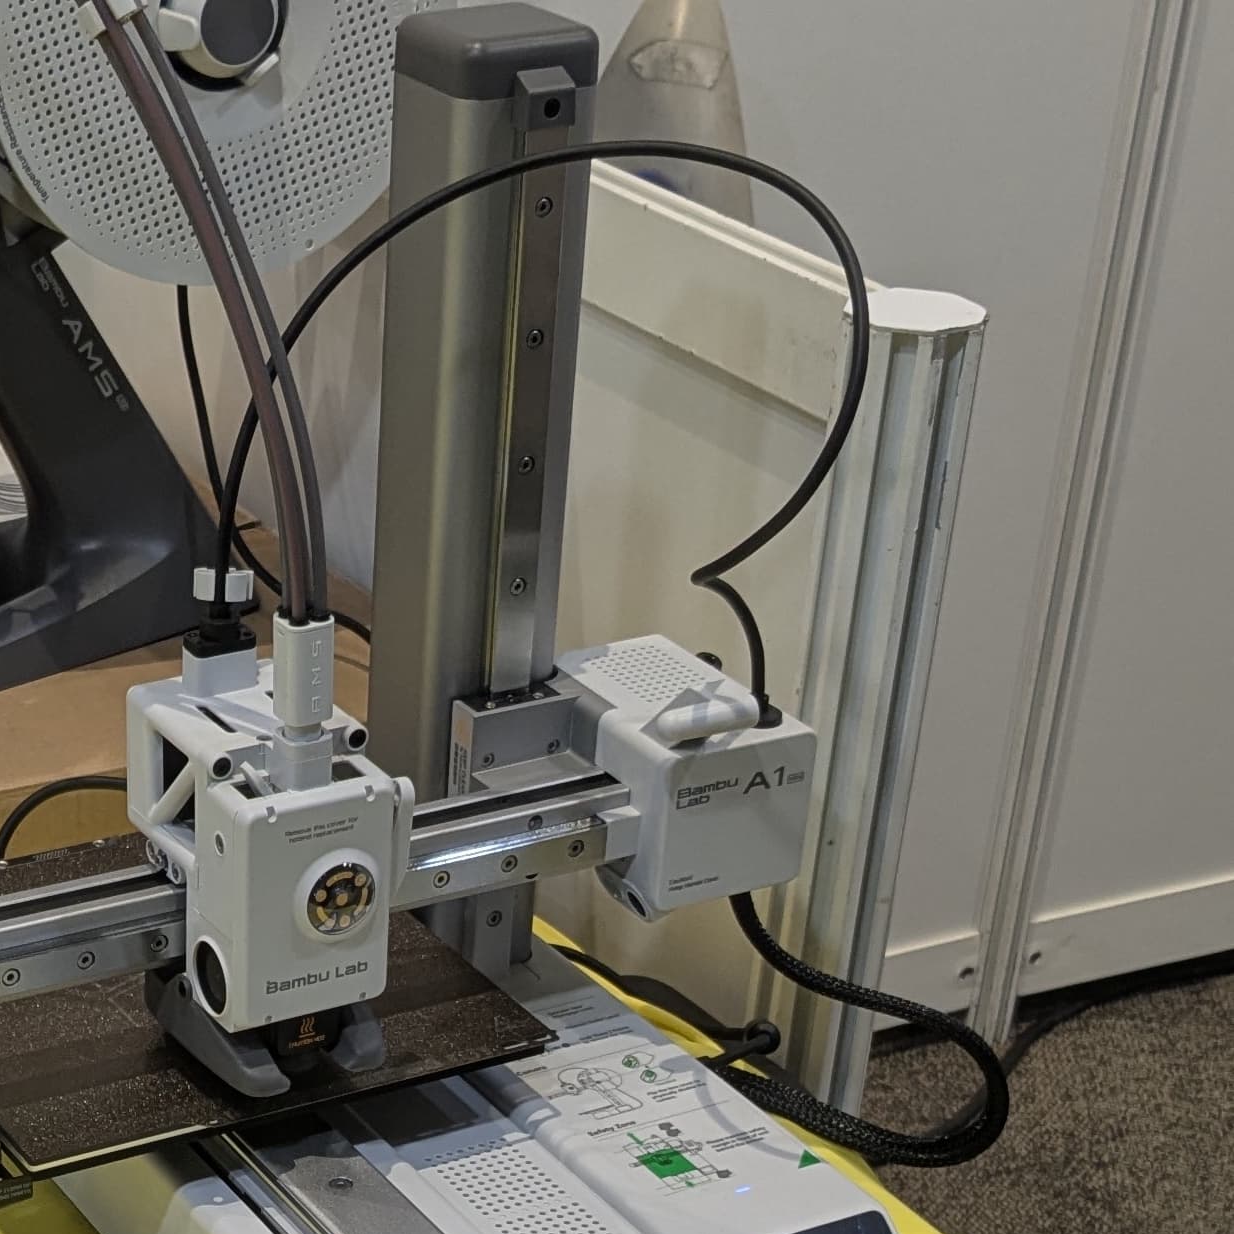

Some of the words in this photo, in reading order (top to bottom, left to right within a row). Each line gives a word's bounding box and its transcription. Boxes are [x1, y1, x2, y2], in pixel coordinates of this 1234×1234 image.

[16, 144, 50, 203] Temperature
[30, 263, 50, 291] Lab
[38, 257, 69, 308] Bambu
[62, 319, 119, 398] AMS
[677, 777, 739, 800] Bambu
[743, 766, 786, 794] A1
[676, 795, 710, 810] Lab
[266, 970, 330, 995] Bambu
[335, 960, 368, 979] Lab
[586, 1125, 615, 1137] Safety
[615, 1120, 637, 1130] Zone
